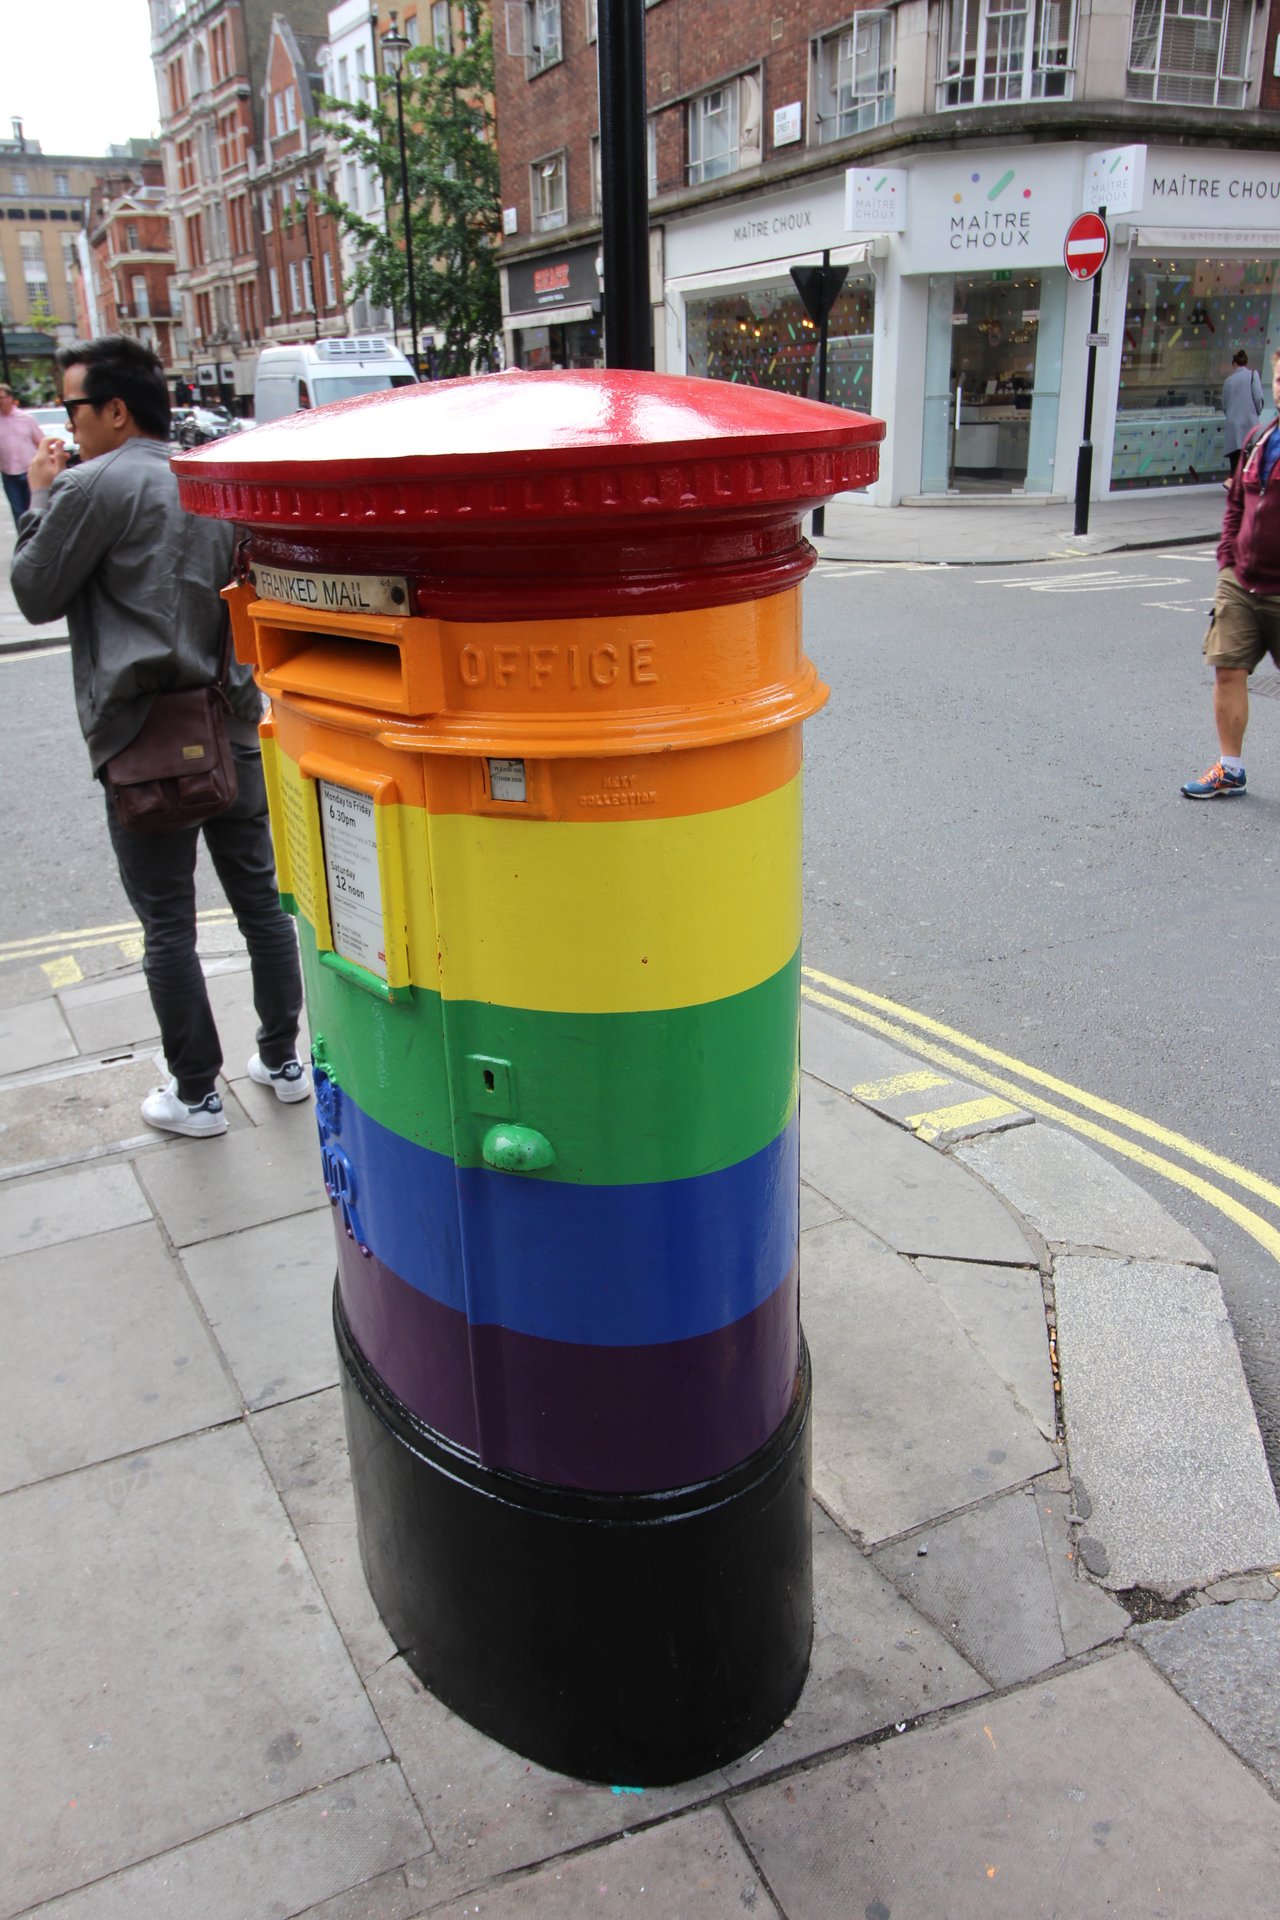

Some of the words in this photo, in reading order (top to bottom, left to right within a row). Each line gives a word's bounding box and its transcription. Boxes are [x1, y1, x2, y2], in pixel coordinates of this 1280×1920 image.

[1152, 174, 1221, 198] MAÎTRE
[856, 197, 896, 210] MAÎTRE
[1091, 190, 1128, 205] CHOUX
[772, 211, 812, 234] CHOUX
[855, 209, 896, 220] CHOUX
[950, 211, 1031, 231] MAÎTRE
[950, 230, 1030, 250] CHOUX
[261, 571, 318, 603] FRANKED
[322, 580, 370, 607] MAIL
[459, 638, 658, 690] OFFICE
[324, 789, 346, 808] Monday
[346, 799, 352, 809] to
[353, 801, 372, 817] Friday
[578, 791, 657, 807] COLLECTION
[329, 804, 357, 827] 6.30pm
[331, 860, 356, 881] Saturday
[335, 874, 347, 891] 12
[347, 885, 365, 900] noon
